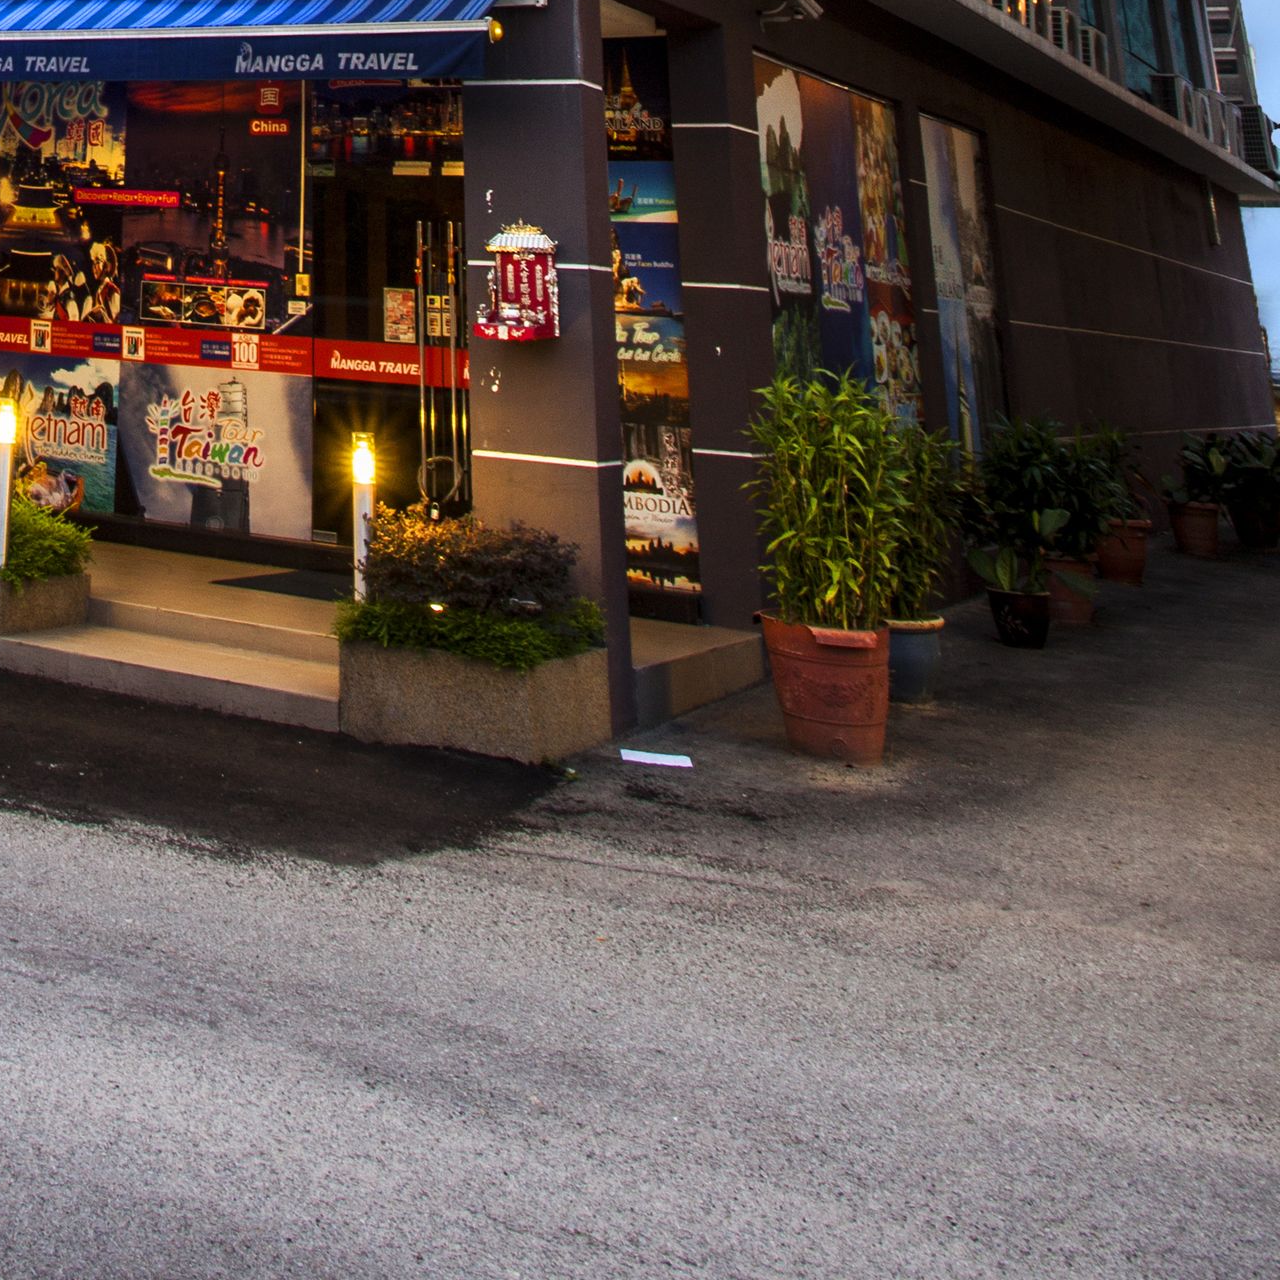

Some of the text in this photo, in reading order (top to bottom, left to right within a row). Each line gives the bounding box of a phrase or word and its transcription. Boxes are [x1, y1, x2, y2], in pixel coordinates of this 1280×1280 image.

[24, 55, 90, 73] TRAVEL
[234, 42, 419, 73] MANGGA TRAVEL
[251, 120, 288, 134] China
[233, 343, 257, 363] 100
[331, 350, 421, 376] MANGGA TRAVE
[72, 396, 105, 419] 越南
[182, 390, 221, 423] 台灣
[171, 425, 264, 467] Taiwan
